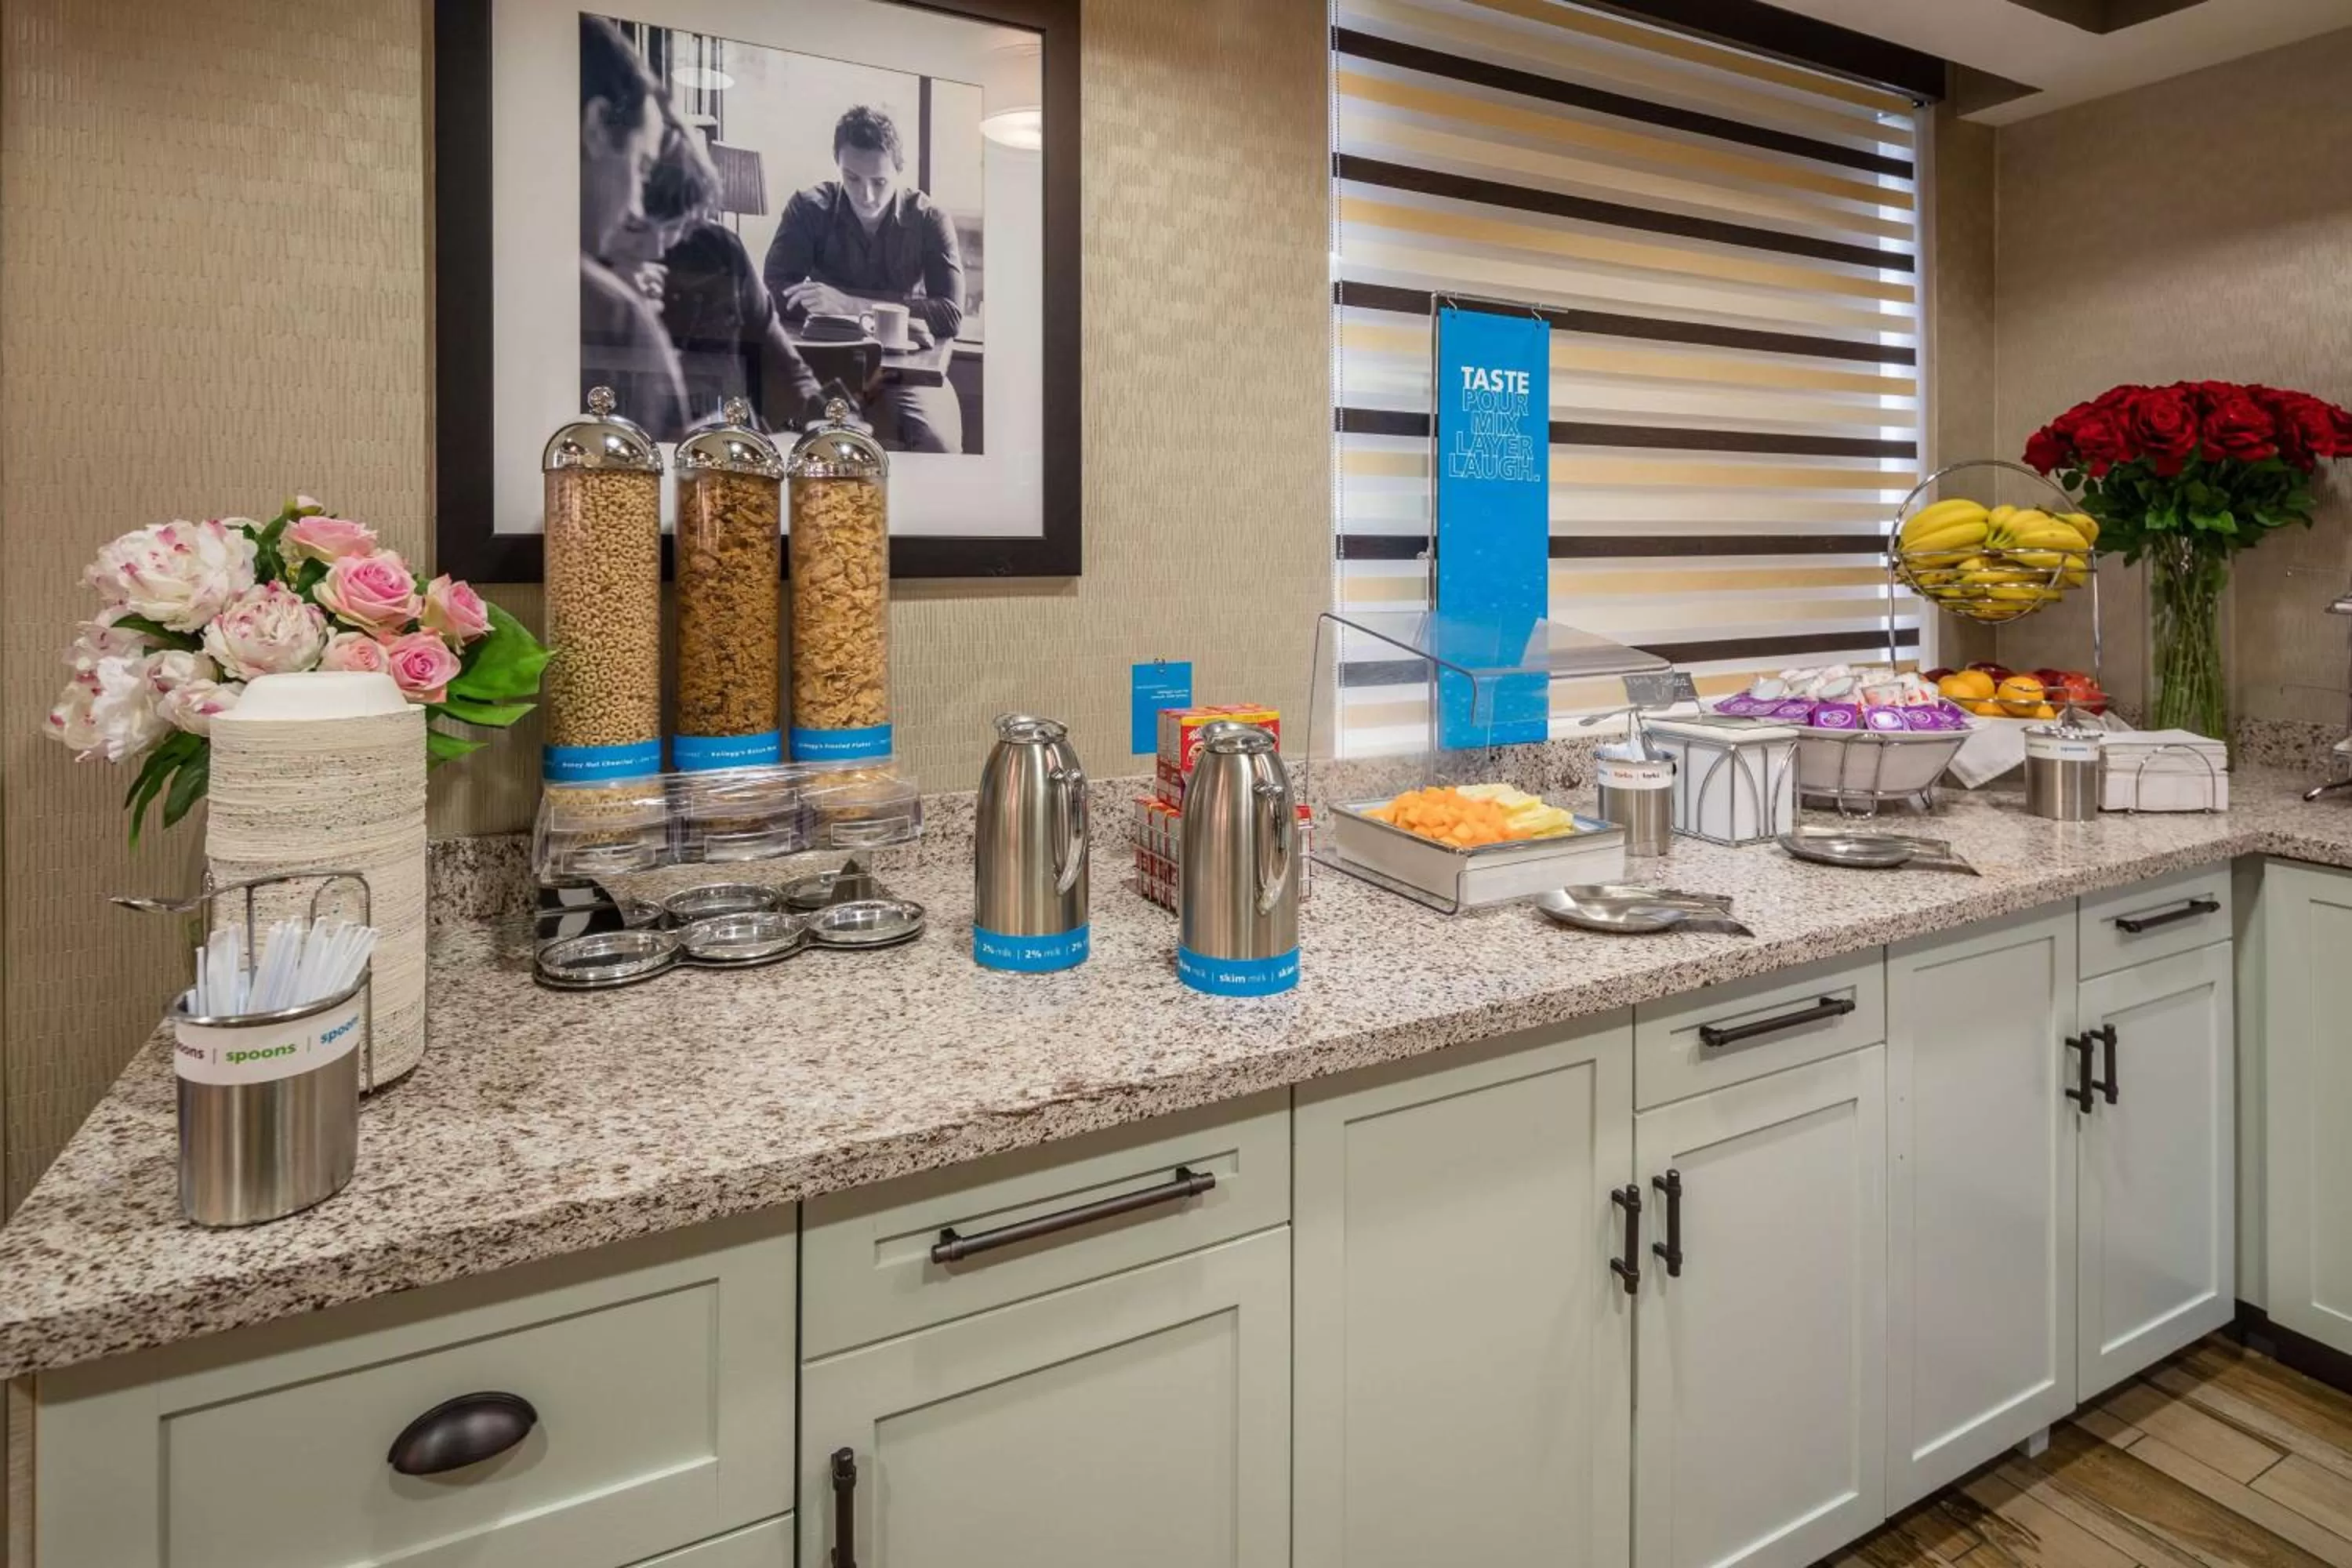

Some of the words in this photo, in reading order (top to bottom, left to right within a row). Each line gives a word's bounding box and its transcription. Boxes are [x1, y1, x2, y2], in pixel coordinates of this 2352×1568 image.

[1461, 366, 1530, 394] TASTE
[1462, 387, 1529, 416] POUR
[1471, 411, 1519, 437] MIX
[1456, 430, 1534, 460] LAYER
[1449, 452, 1541, 482] LAUGH.
[1025, 949, 1042, 959] 2%
[1219, 972, 1246, 984] skim
[226, 1043, 297, 1065] spoons
